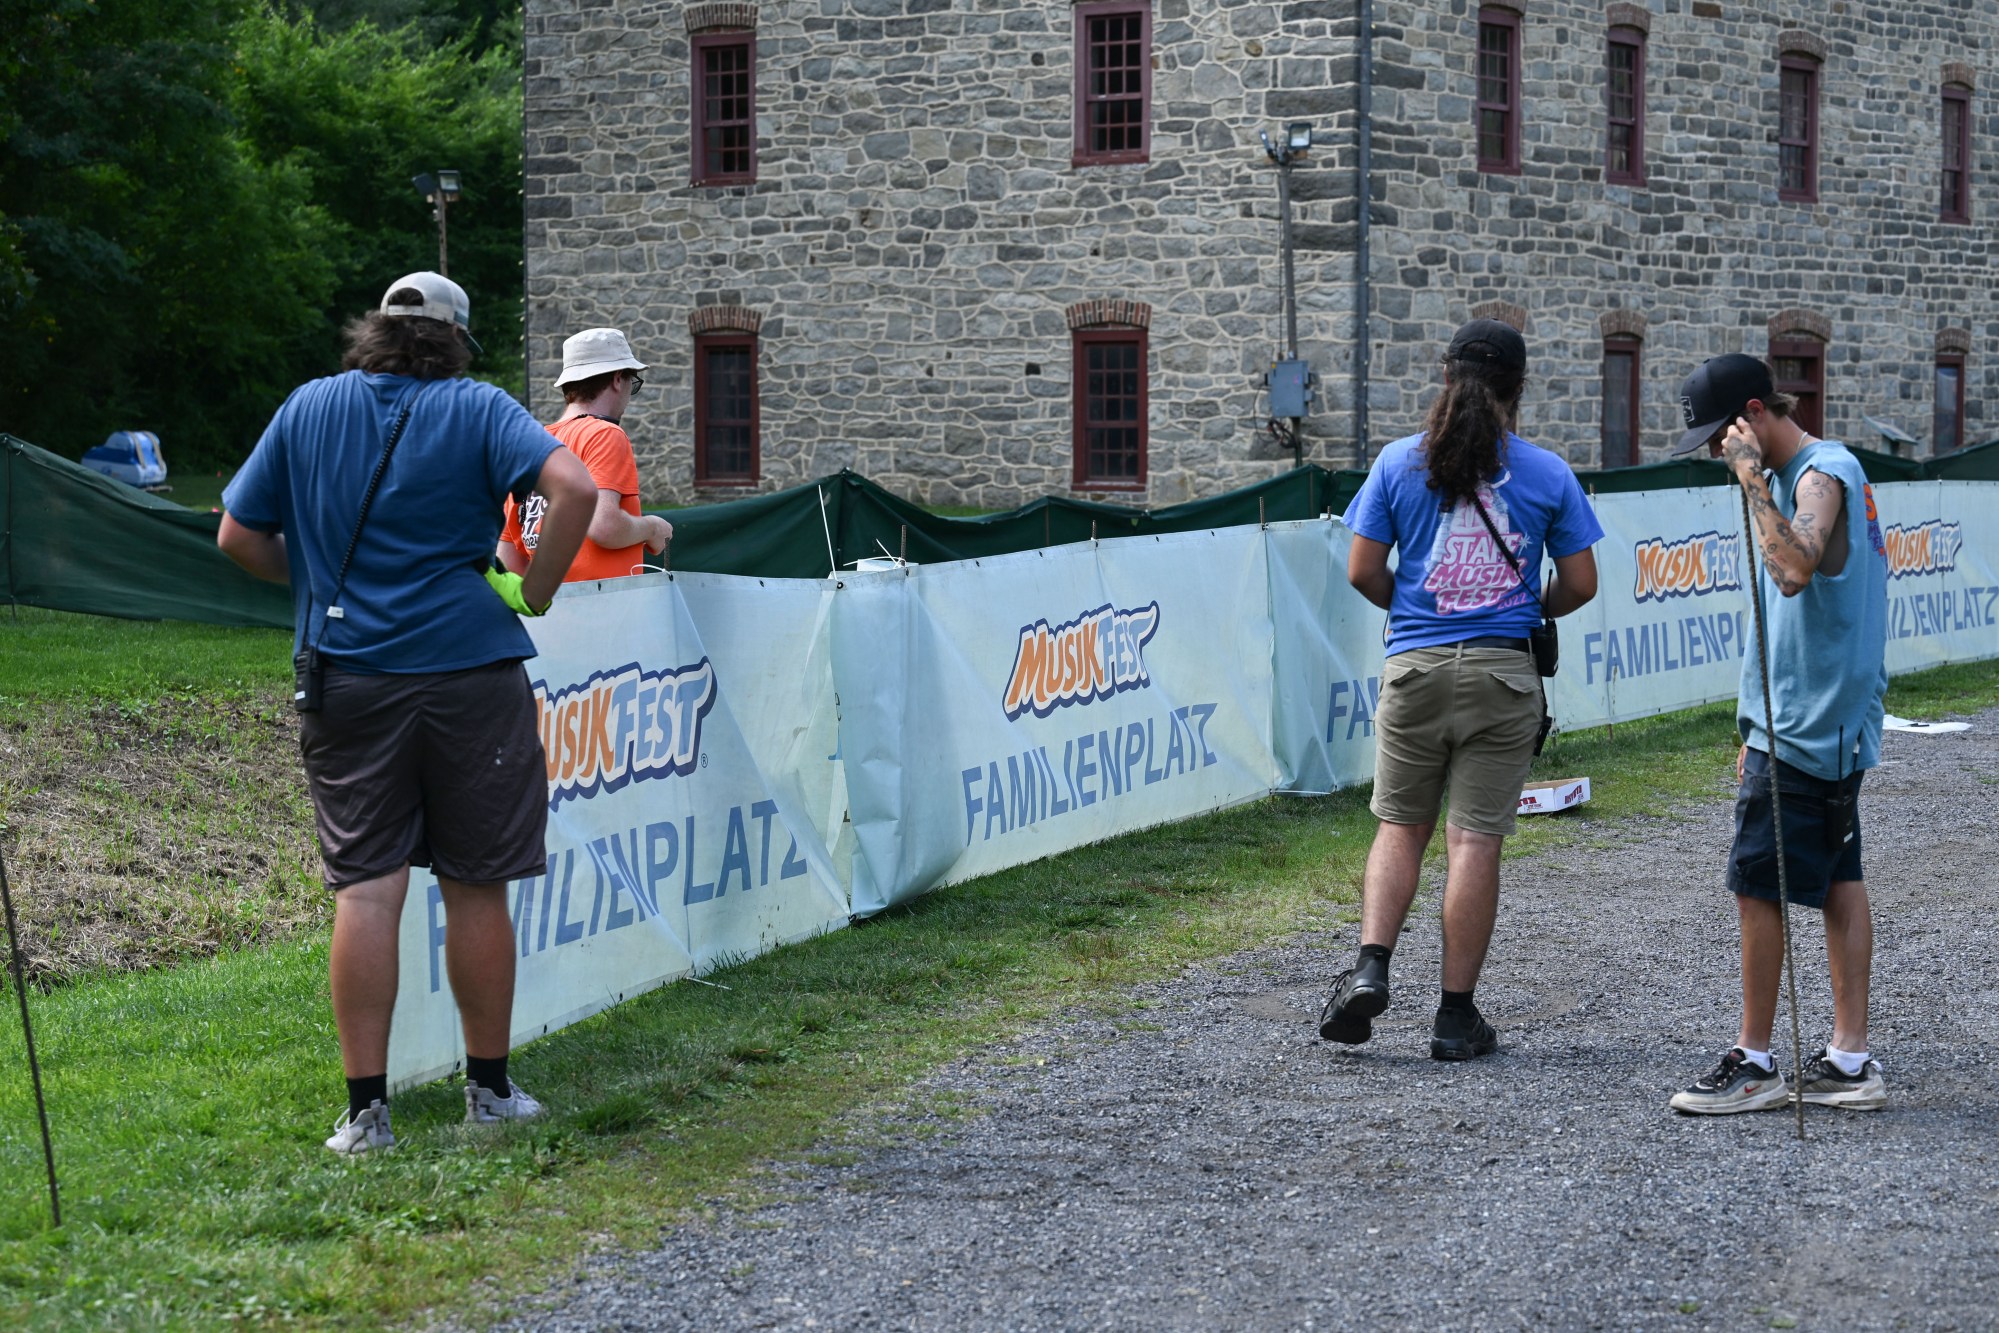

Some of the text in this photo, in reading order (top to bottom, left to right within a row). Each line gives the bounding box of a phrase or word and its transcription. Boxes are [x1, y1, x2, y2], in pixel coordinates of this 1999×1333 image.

[1003, 602, 1159, 718] MUSIKFEST
[1584, 611, 1745, 685] FAMILIENPL
[1886, 586, 1999, 640] ILIENPLATZ
[962, 703, 1218, 846] FAMILIENPLATZ
